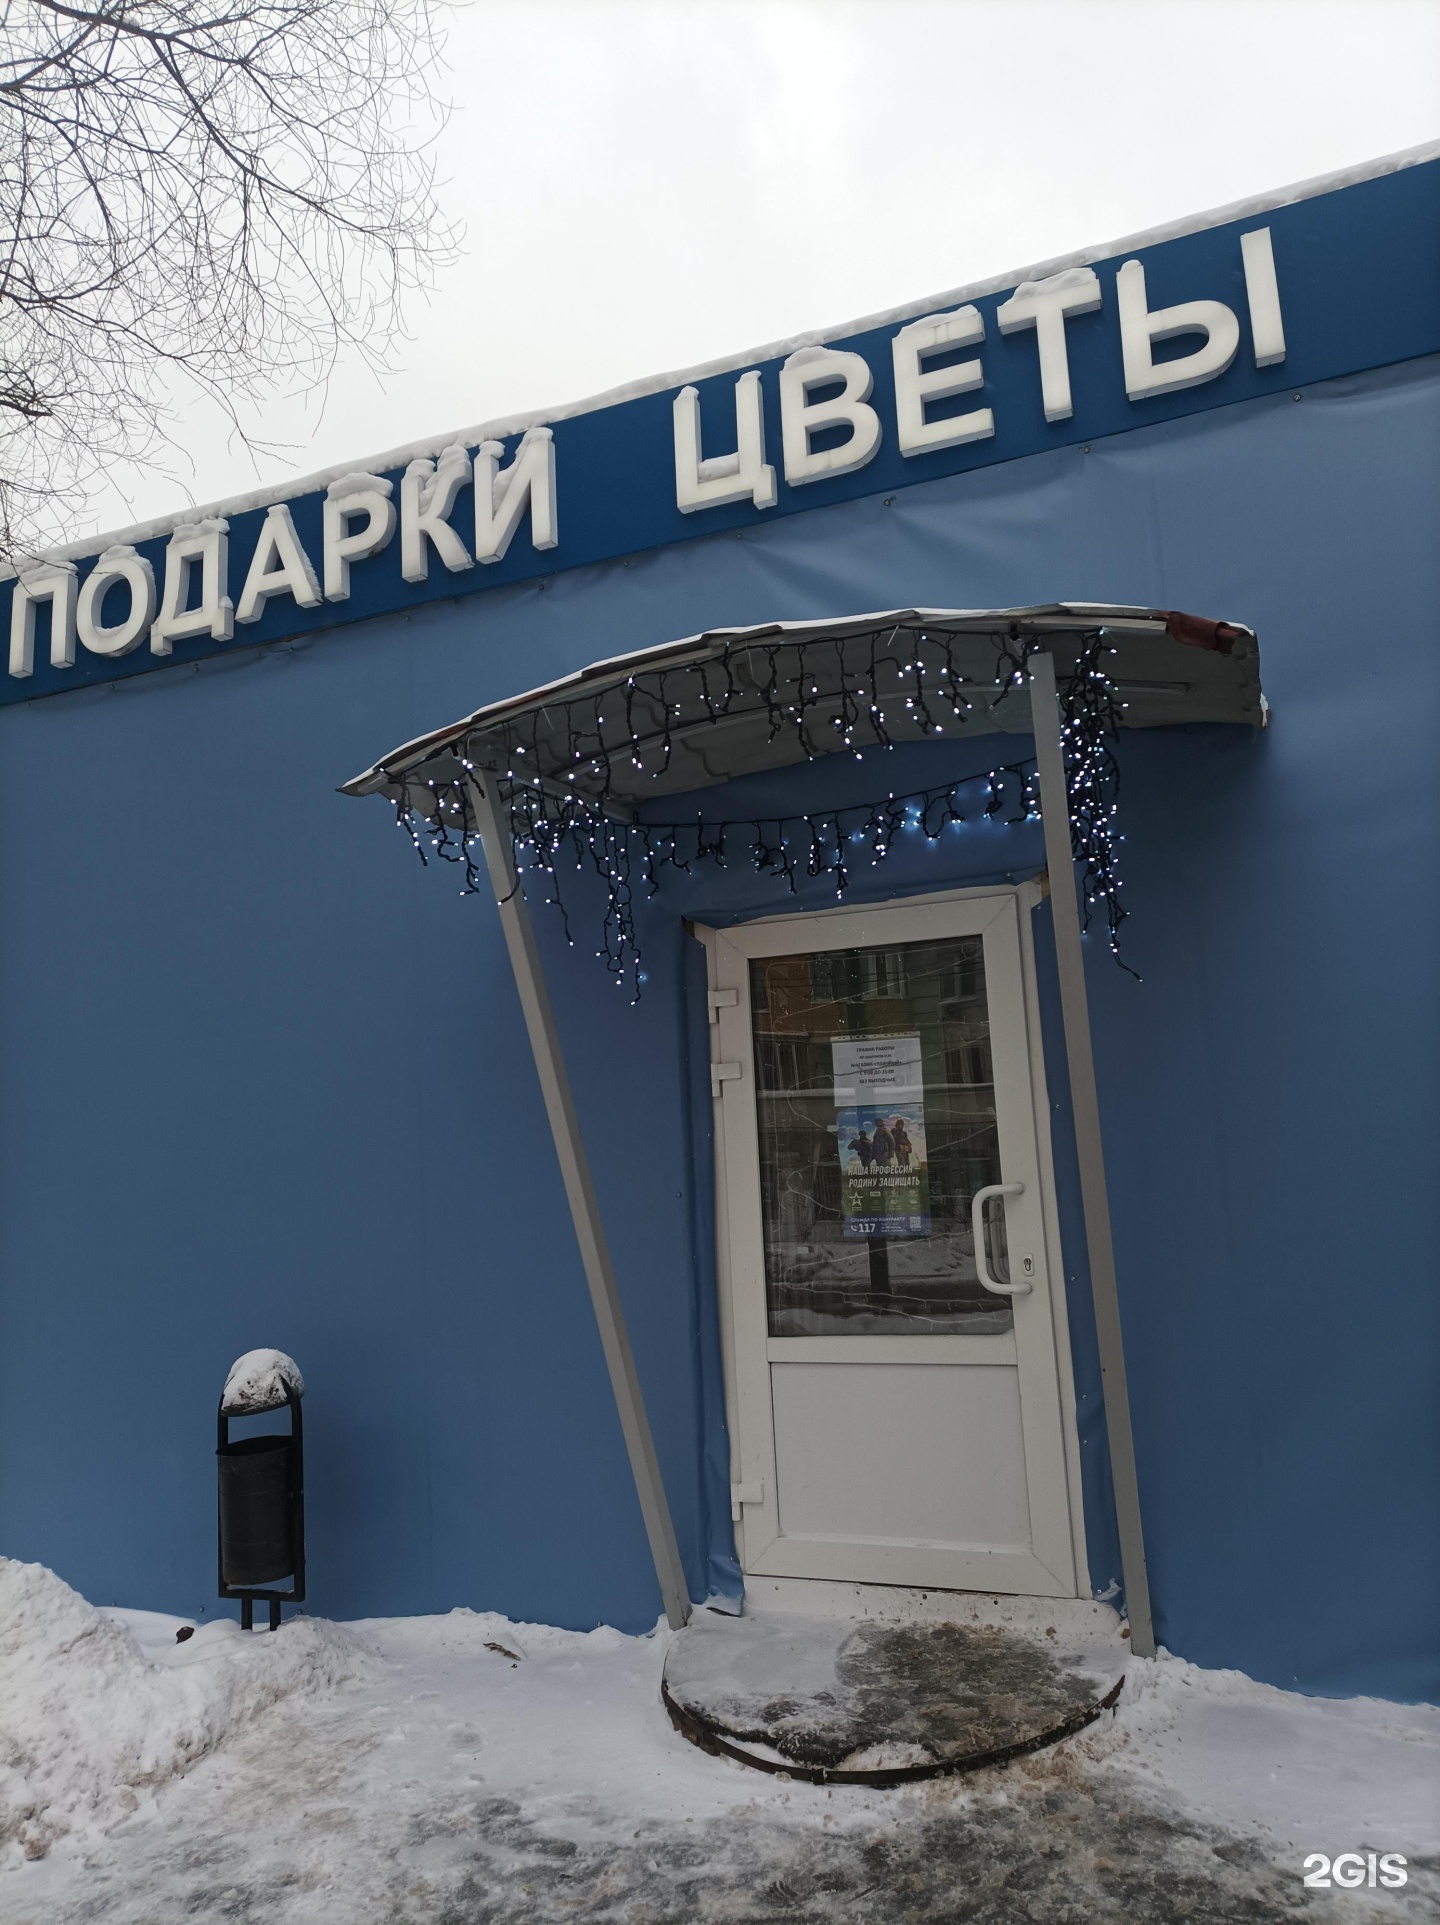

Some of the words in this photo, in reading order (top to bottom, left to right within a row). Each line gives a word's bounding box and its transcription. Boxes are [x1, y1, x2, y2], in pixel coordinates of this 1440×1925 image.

[8, 429, 559, 679] ПОДАРКИ
[672, 226, 1287, 515] ЦВЕТЫ
[848, 1166, 869, 1175] НАША
[870, 1164, 913, 1175] ПРОФЕССИЯ
[848, 1177, 878, 1188] РОДИНУ
[879, 1176, 920, 1187] ЗАЩИЩАТЬ
[859, 1223, 876, 1233] 117
